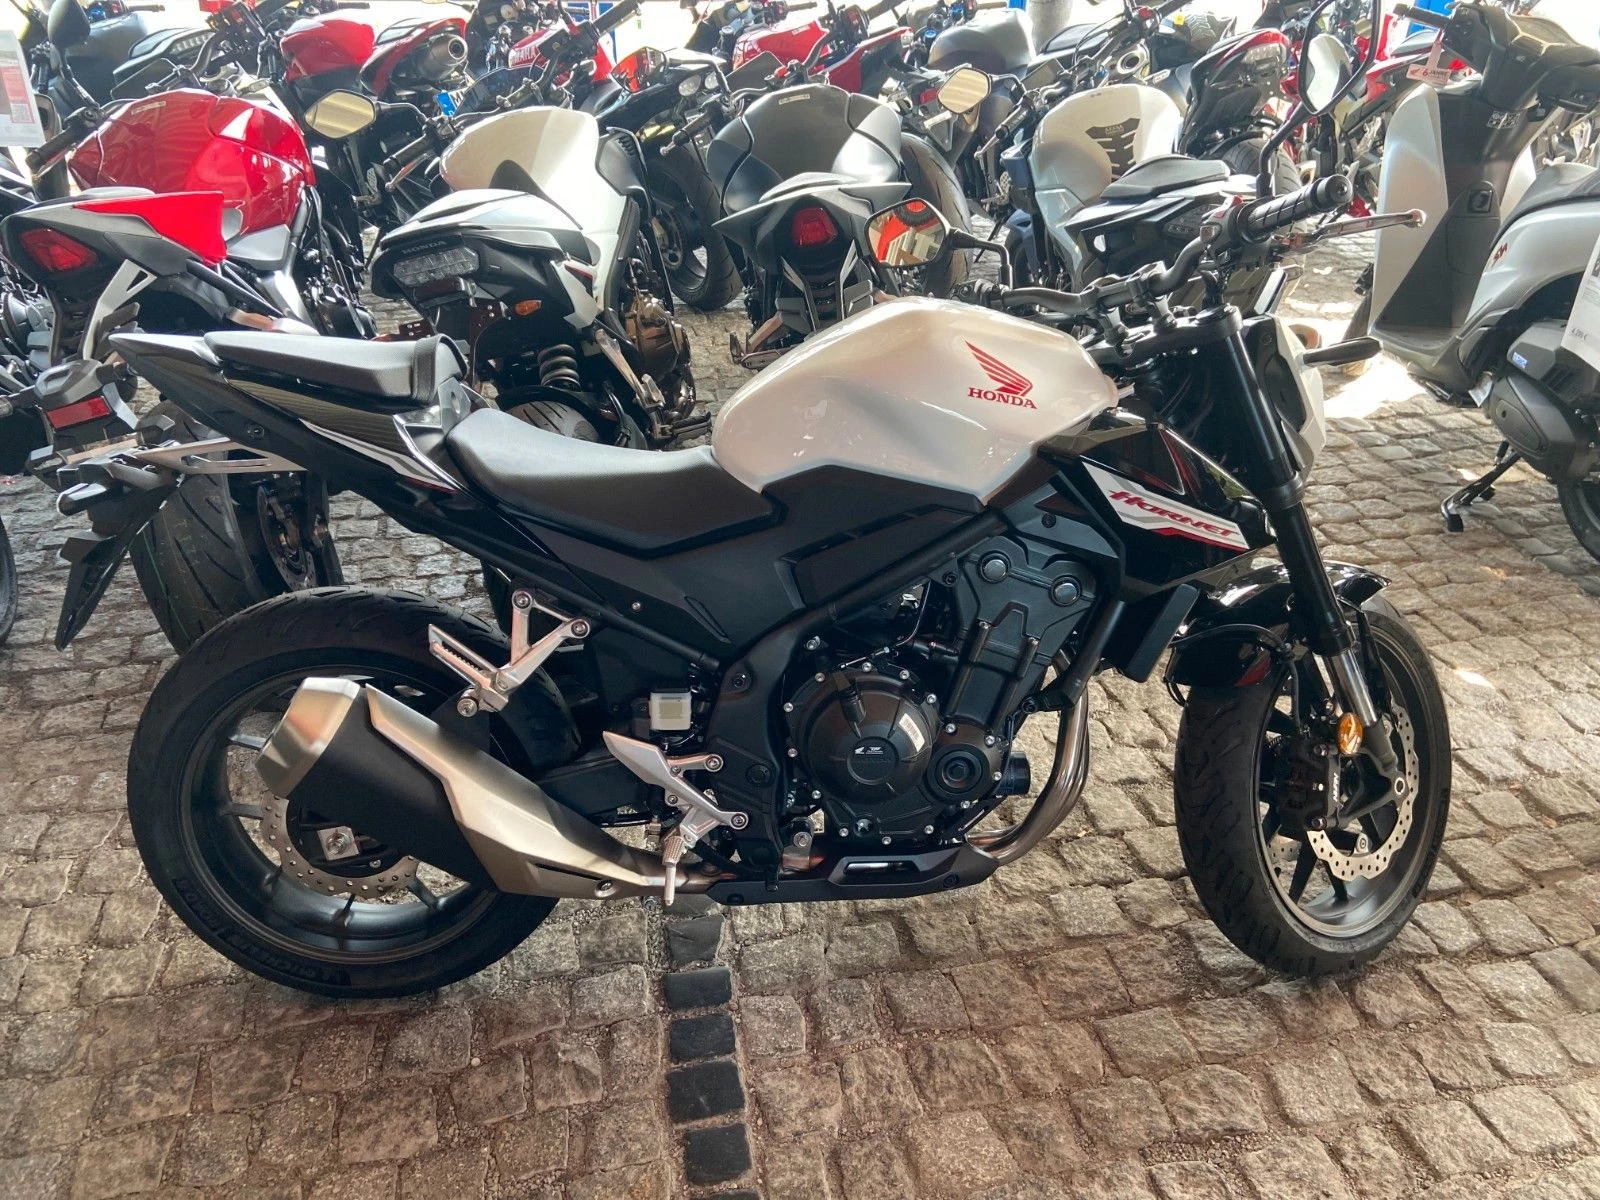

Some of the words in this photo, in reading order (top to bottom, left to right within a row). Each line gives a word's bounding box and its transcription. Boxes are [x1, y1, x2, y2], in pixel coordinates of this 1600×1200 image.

[401, 241, 447, 254] HONDA
[968, 387, 1037, 409] HONDA
[1109, 490, 1240, 536] HORNET
